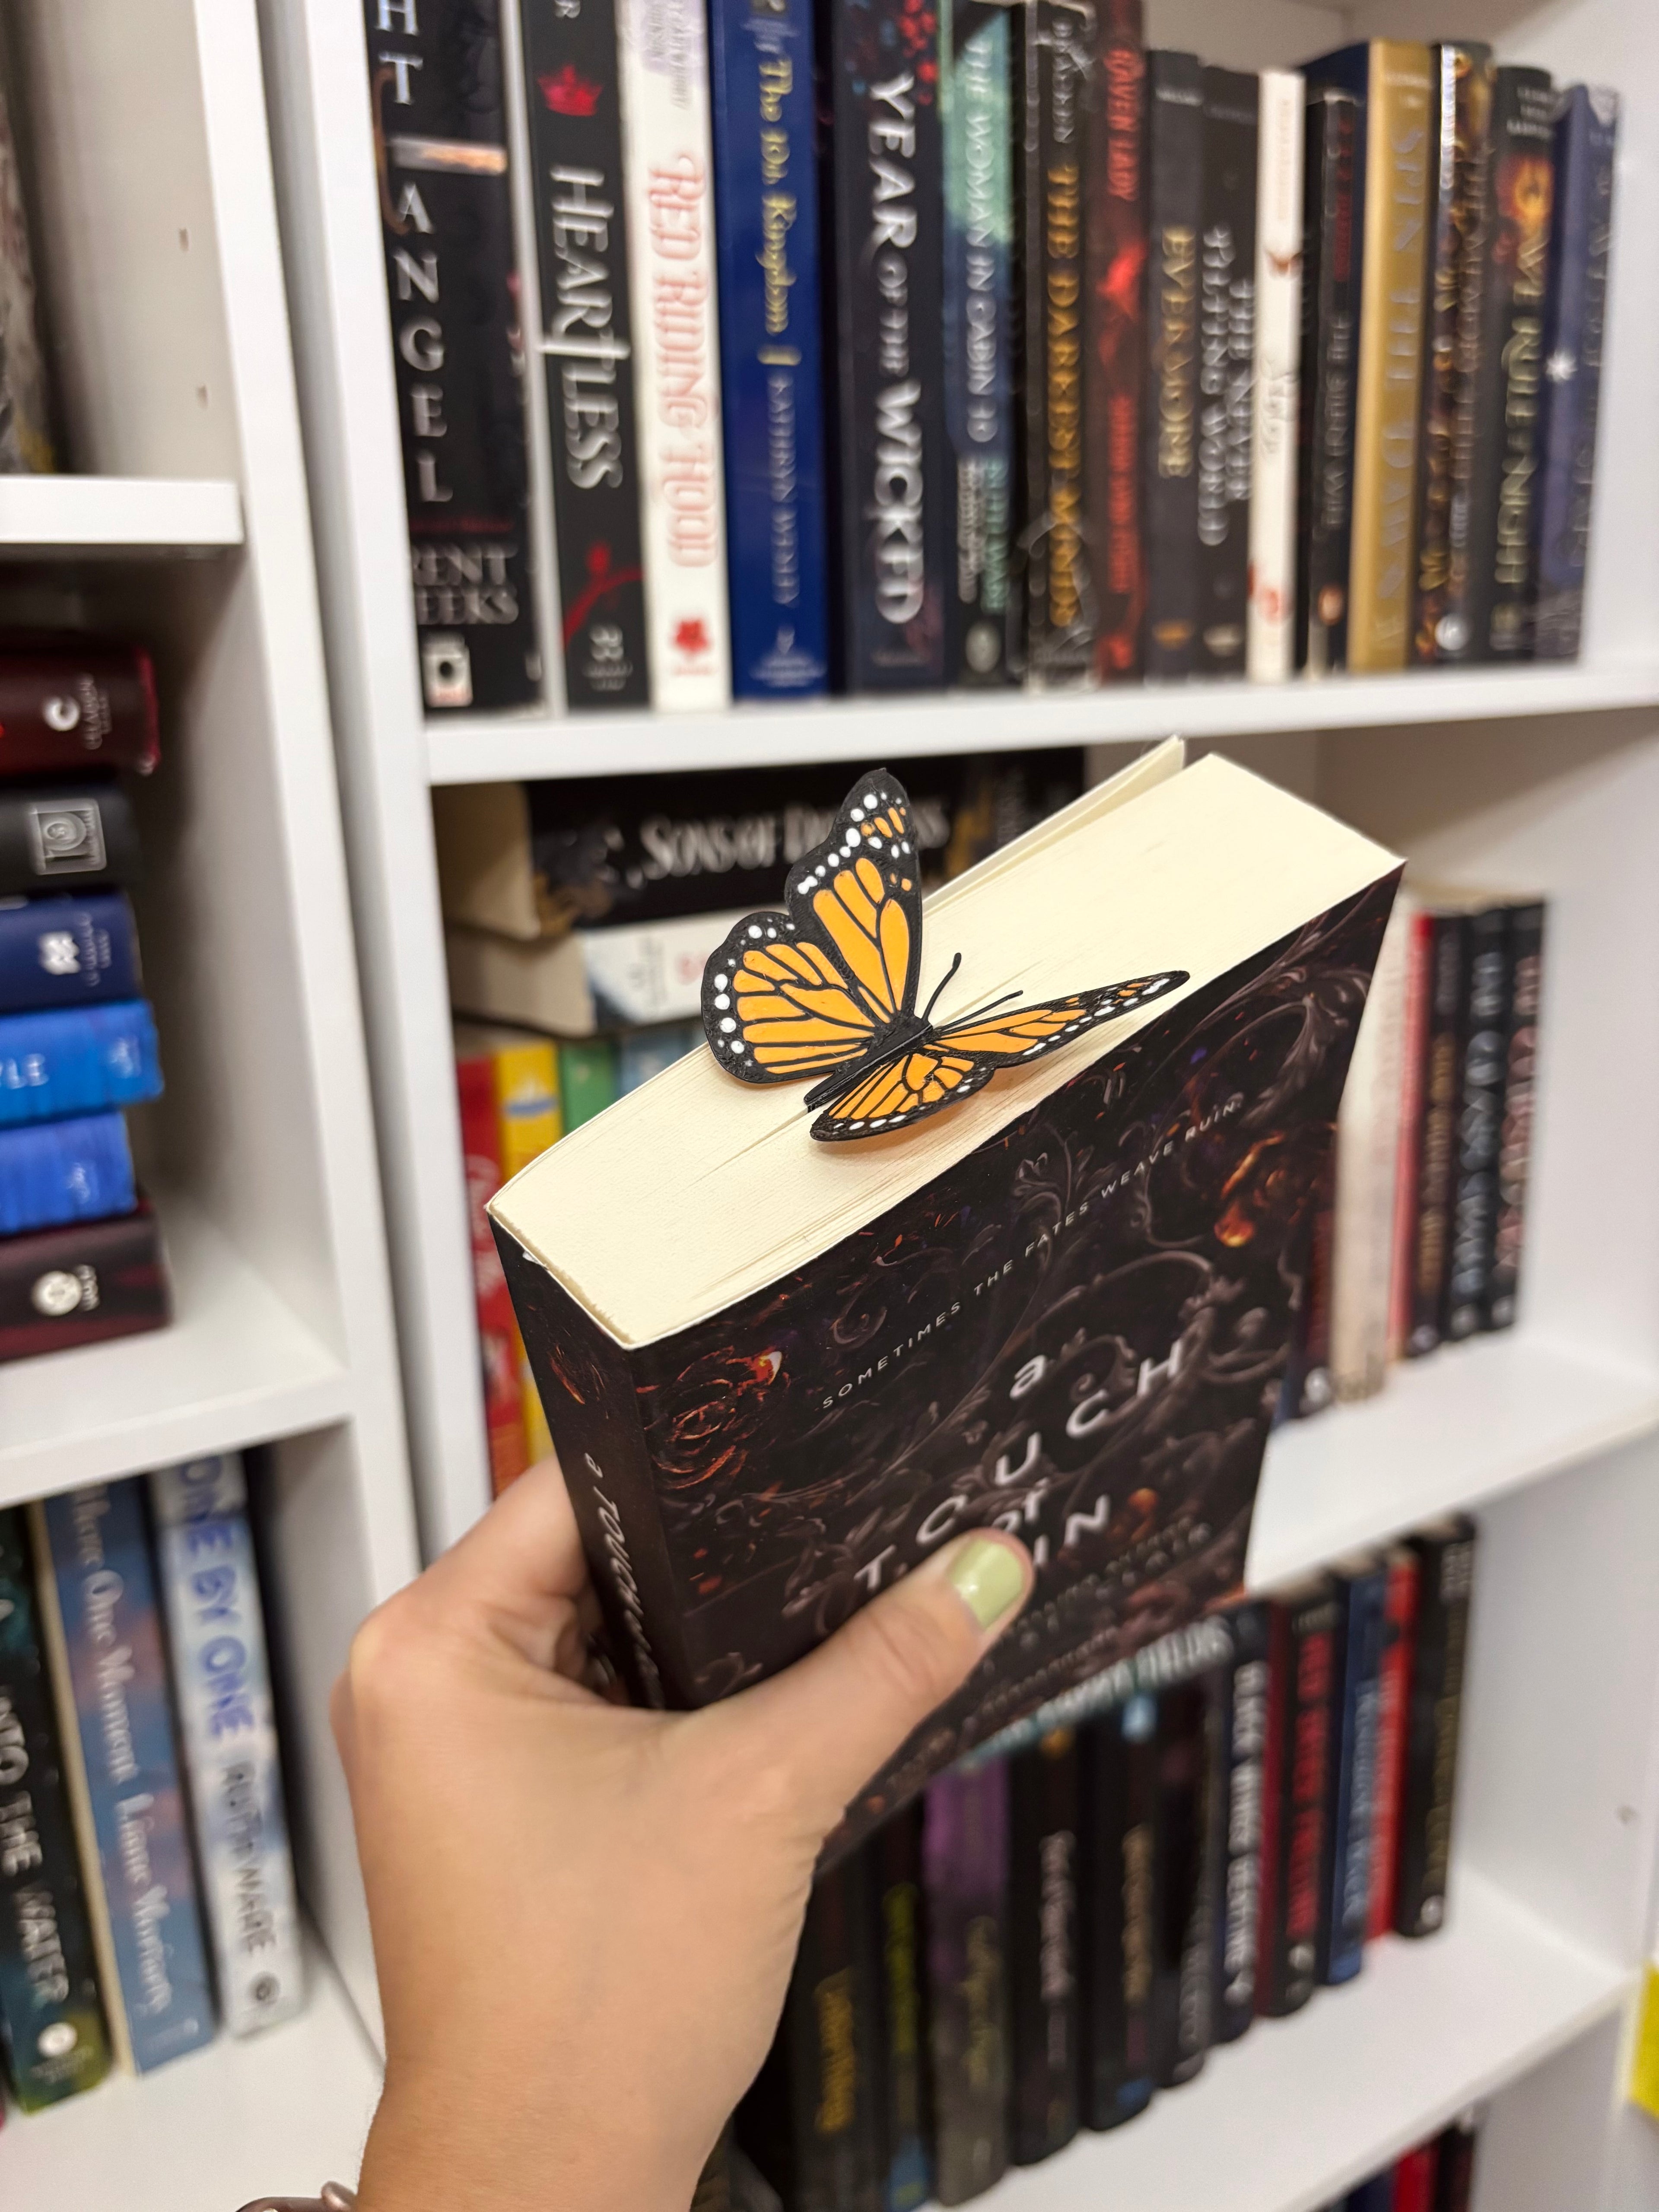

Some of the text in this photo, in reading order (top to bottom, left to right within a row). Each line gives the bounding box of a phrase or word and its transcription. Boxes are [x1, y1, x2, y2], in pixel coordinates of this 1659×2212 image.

[758, 55, 792, 122] The
[965, 36, 994, 101] THE
[1103, 47, 1145, 202] RAVEN LADY
[867, 71, 918, 259] YEAR
[965, 109, 995, 248] WOMAN
[539, 164, 631, 489] HEARTLESS
[755, 194, 798, 335] Kingdom
[877, 253, 908, 307] OF
[966, 252, 995, 292] IN
[648, 153, 718, 568] RED RIDING HOOD
[879, 308, 909, 377] THE
[966, 294, 997, 396] CABIN
[1047, 165, 1081, 627] THE DARKEST MINDS
[1378, 128, 1425, 599] SPIN THE DAWN
[873, 378, 925, 624] WICKED
[823, 1302, 961, 1409] SOMETIMES
[973, 1259, 1014, 1295] THE
[1025, 1201, 1089, 1257] FATES
[1101, 1141, 1174, 1198] WEAVE
[81, 1570, 124, 1647] One
[179, 1455, 255, 1740] ONE BY ONE
[592, 1485, 644, 1618] TOUCH
[95, 1645, 140, 1784] Moment
[235, 1864, 277, 1955] WARE
